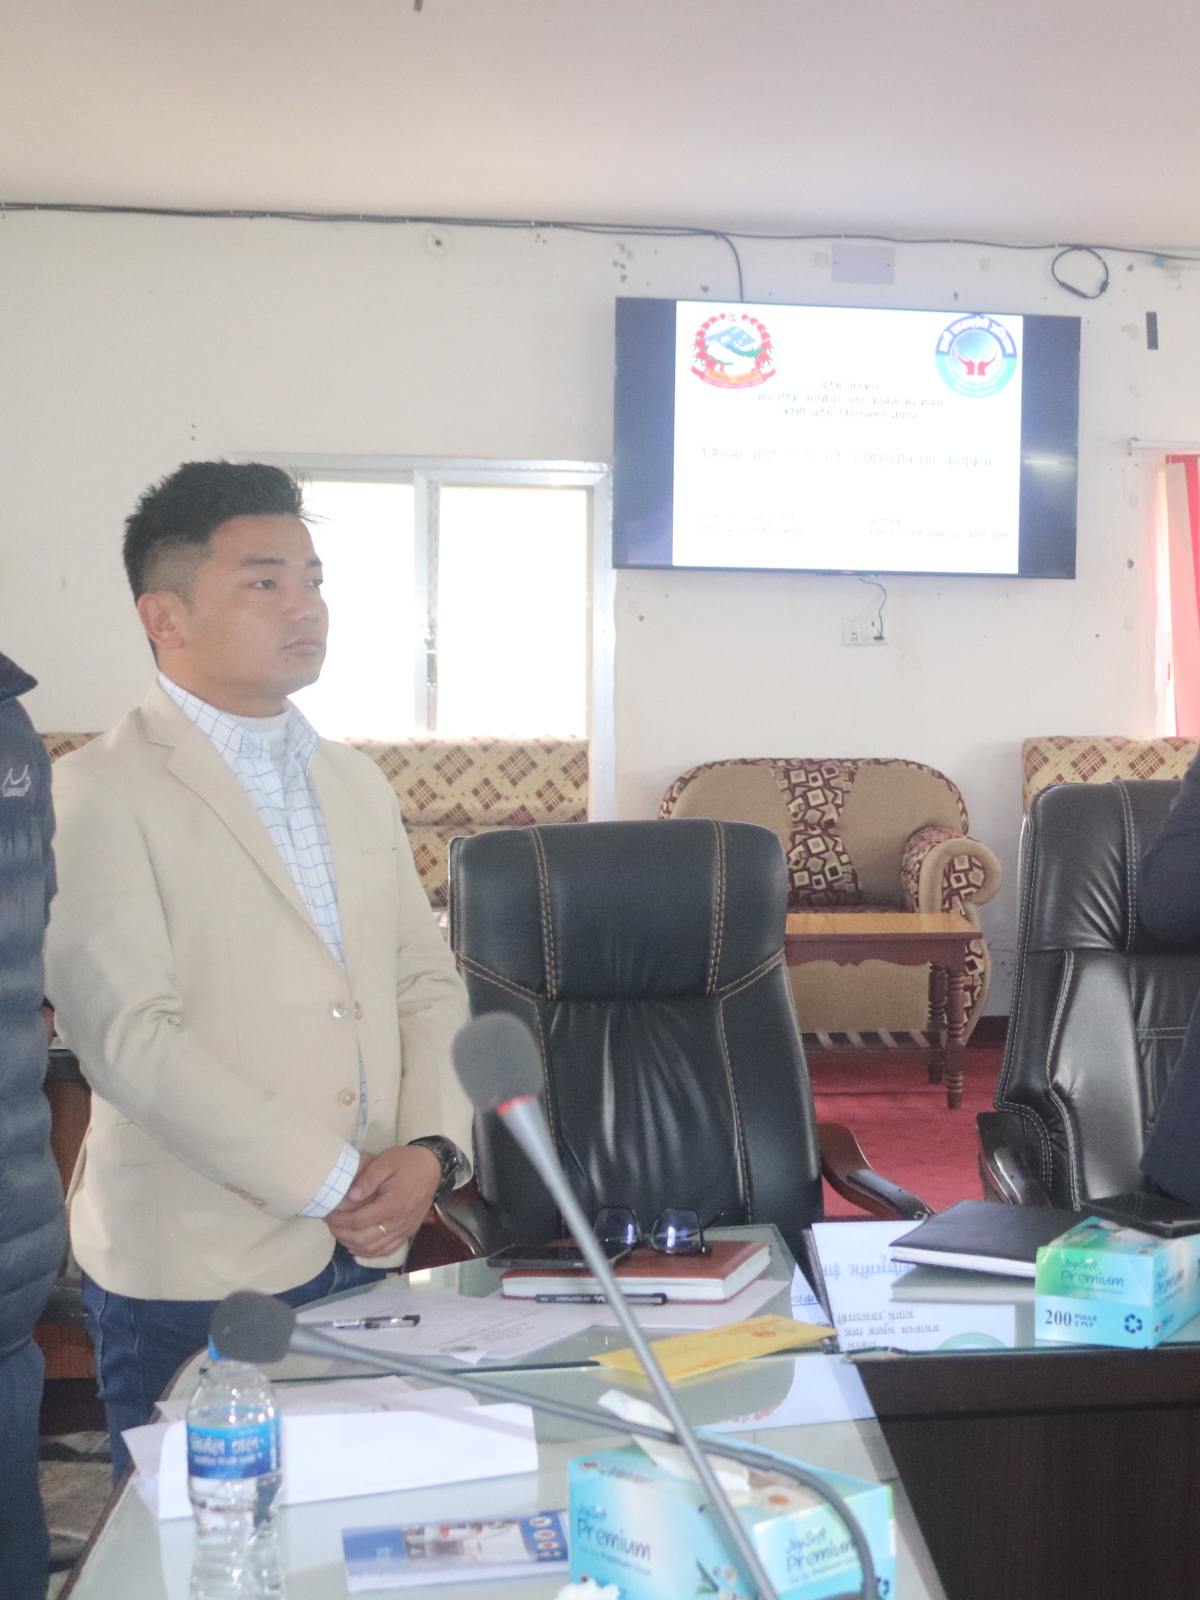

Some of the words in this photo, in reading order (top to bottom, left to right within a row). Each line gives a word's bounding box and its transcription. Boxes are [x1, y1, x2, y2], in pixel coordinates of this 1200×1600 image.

[1061, 1270, 1124, 1288] Premium
[1045, 1310, 1072, 1327] 200
[577, 1516, 651, 1561] Premium
